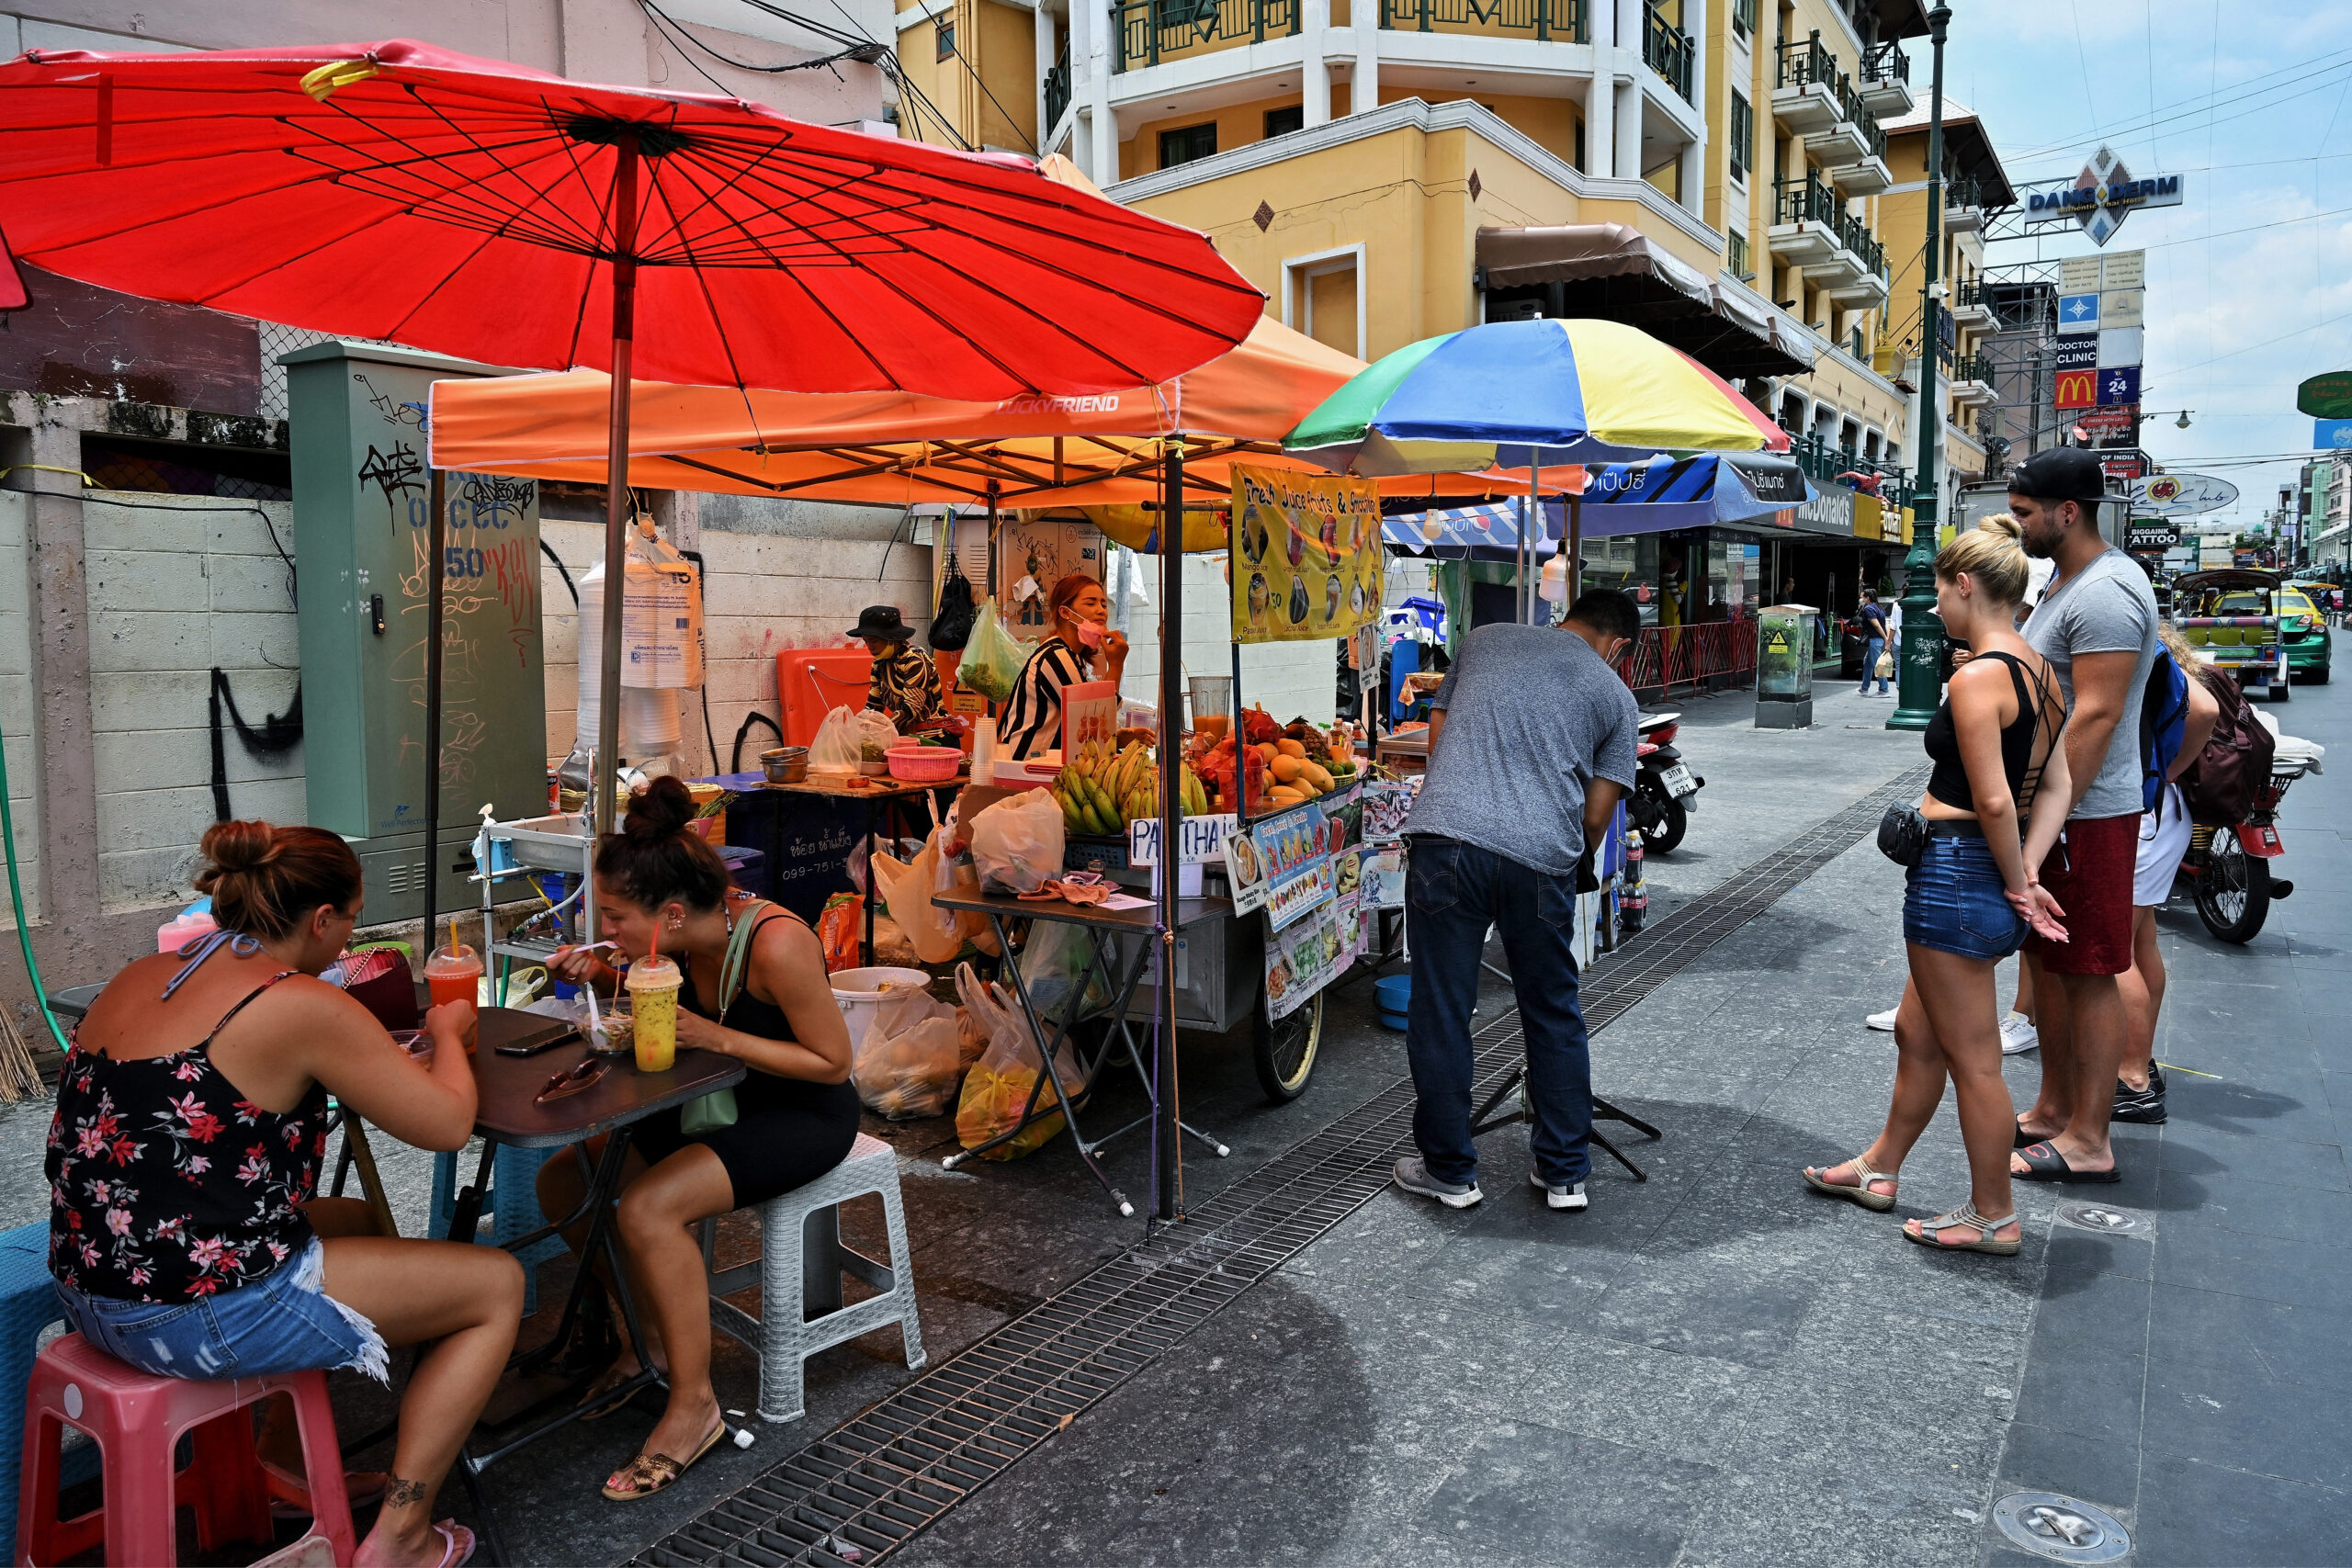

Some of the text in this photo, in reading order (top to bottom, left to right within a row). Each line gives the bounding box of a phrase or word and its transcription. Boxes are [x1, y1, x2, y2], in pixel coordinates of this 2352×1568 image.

[2030, 176, 2177, 210] DANG DERM
[2123, 197, 2146, 205] Hotel
[2058, 341, 2097, 351] DOCTOR
[2057, 352, 2096, 364] CLINIC
[2109, 380, 2127, 392] 24
[997, 395, 1119, 414] LUCKYFRIEND
[1599, 469, 1645, 491] เป๊ปซี่
[1243, 477, 1275, 506] Fresh
[1282, 484, 1306, 511] Juice
[1338, 491, 1346, 514] &
[1798, 491, 1850, 527] McDonald's
[1676, 784, 1690, 795] 621
[1133, 819, 1159, 860] PA
